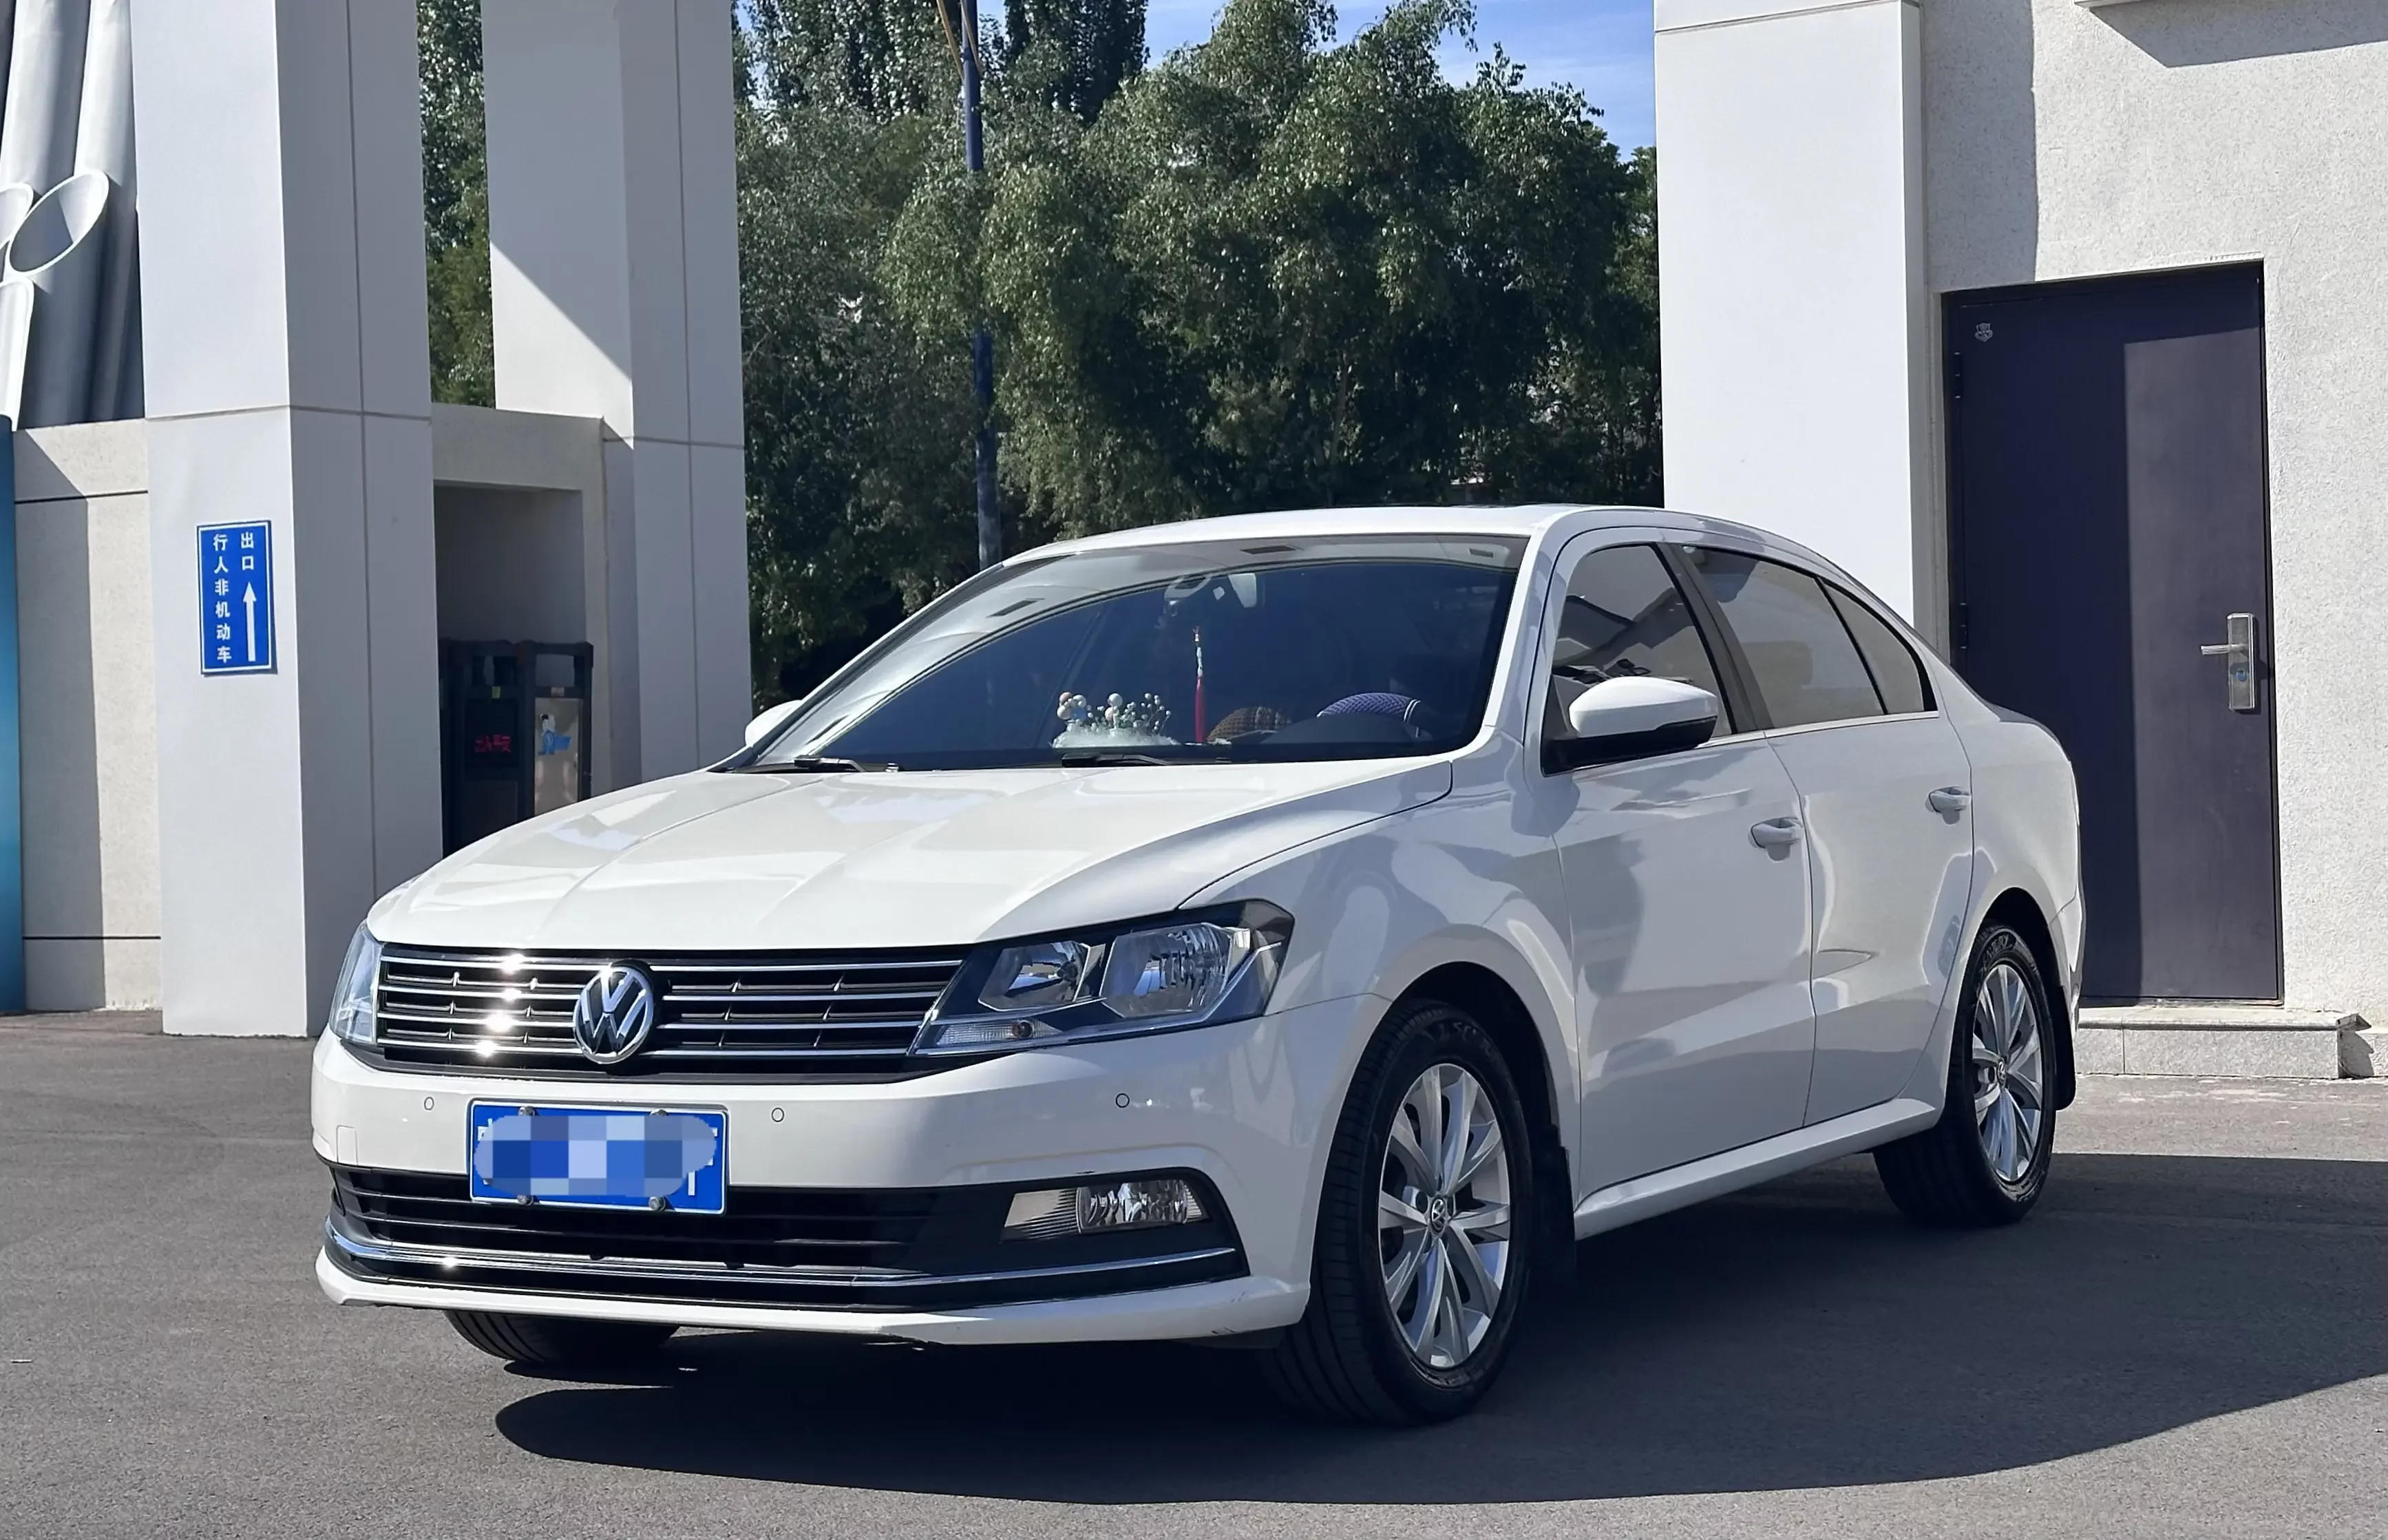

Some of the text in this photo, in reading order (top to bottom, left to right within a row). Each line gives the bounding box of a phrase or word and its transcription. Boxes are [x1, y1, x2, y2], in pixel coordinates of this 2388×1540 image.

[240, 531, 255, 571] 出口
[213, 534, 232, 663] 行人非机动车
